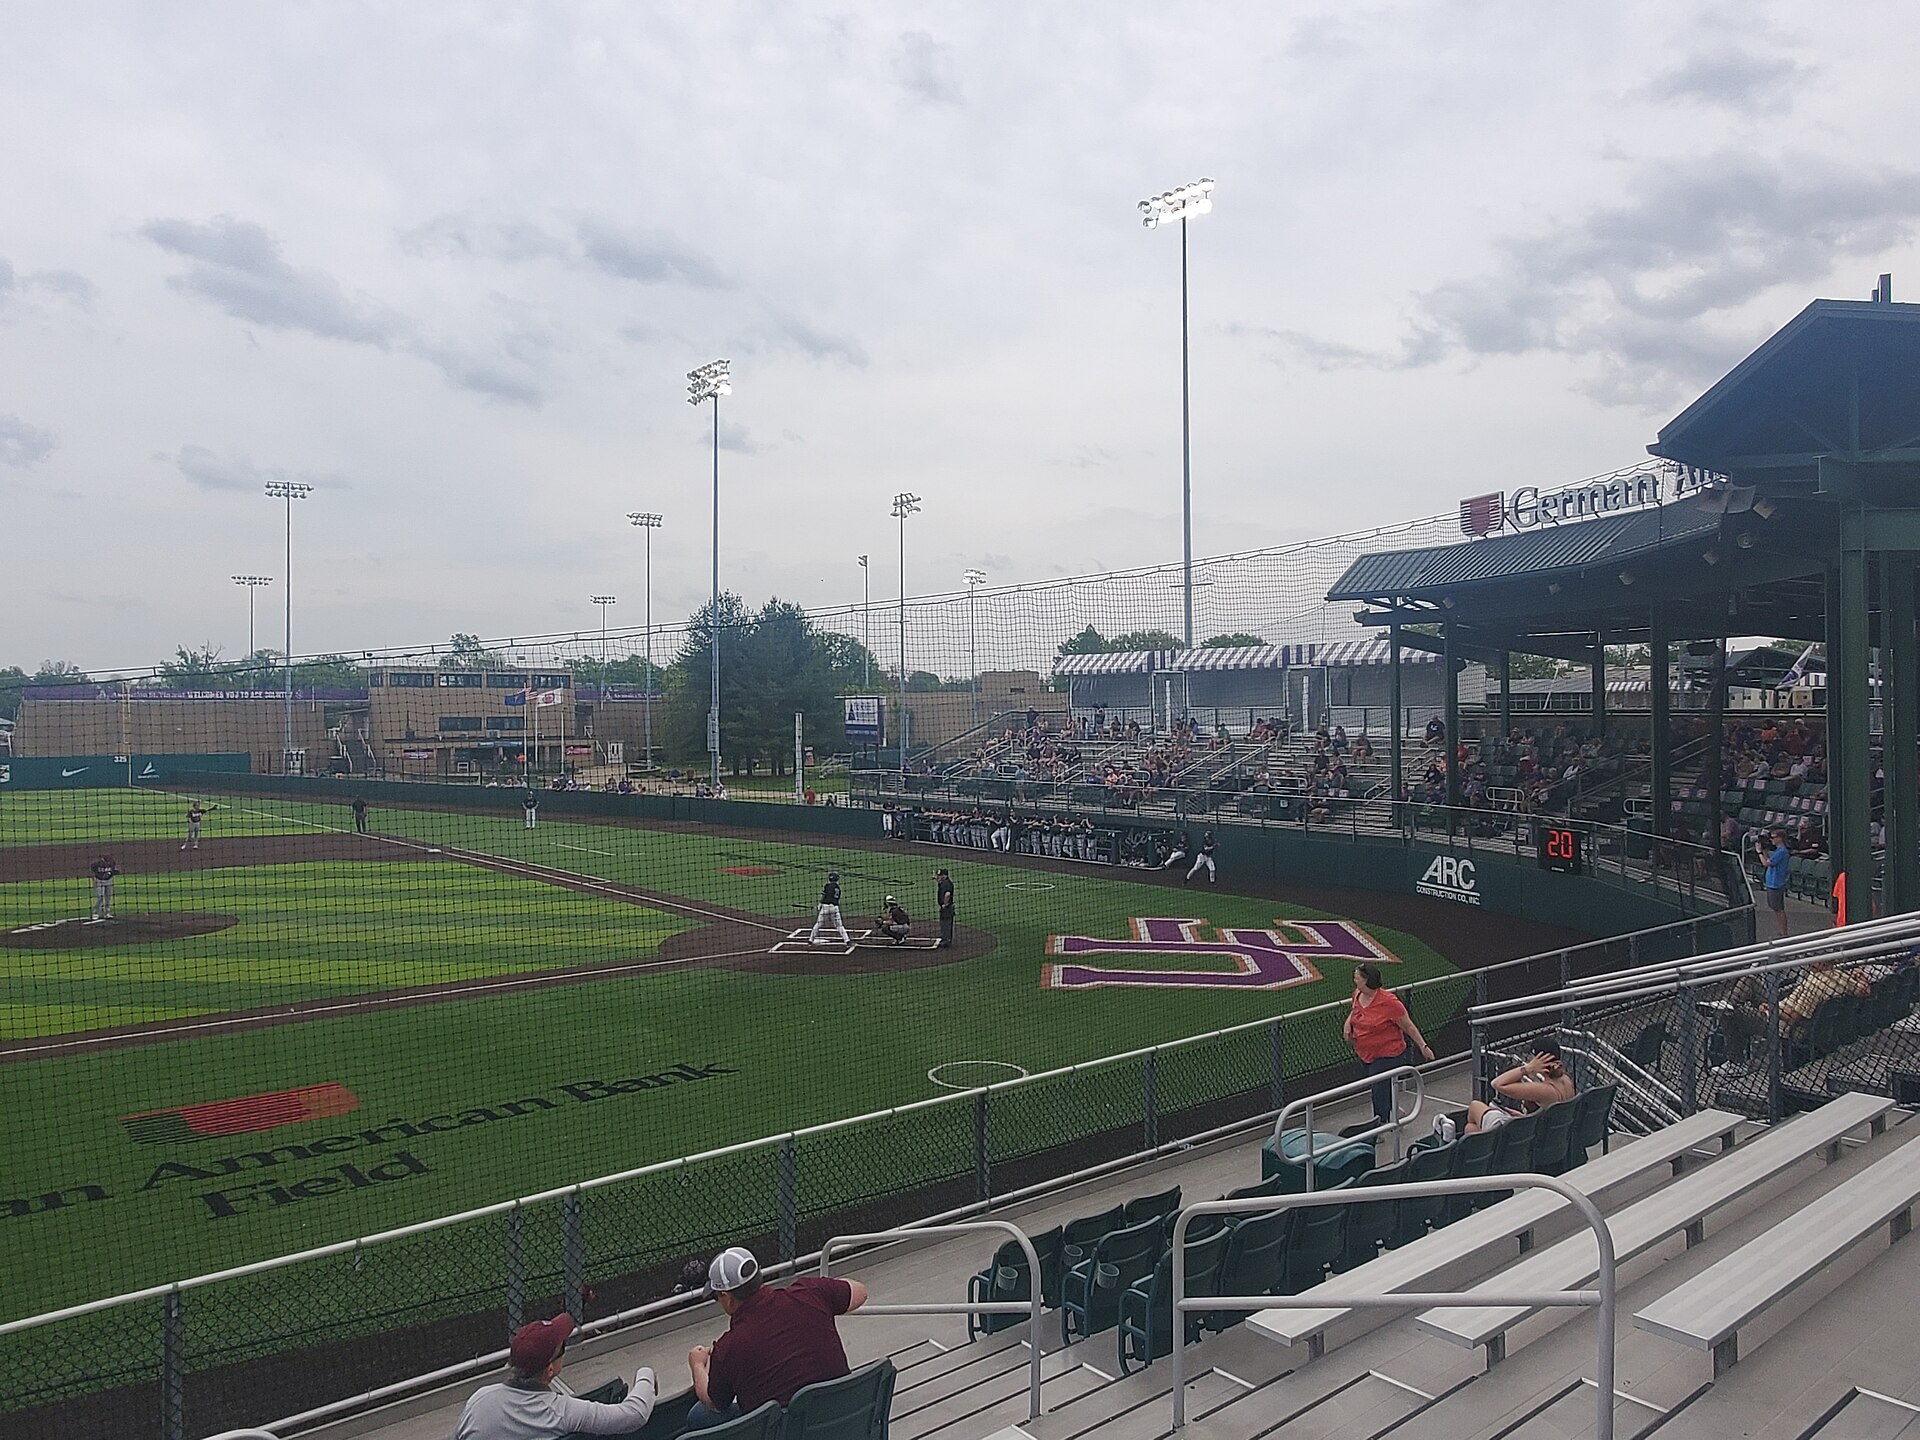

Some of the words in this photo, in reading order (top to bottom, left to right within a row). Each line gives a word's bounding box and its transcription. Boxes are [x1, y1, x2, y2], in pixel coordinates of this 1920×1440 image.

[1508, 473, 1658, 528] German
[187, 691, 224, 699] WELCOMES
[225, 691, 240, 699] YOU
[241, 691, 249, 699] TO
[1547, 830, 1573, 859] 20
[1422, 855, 1476, 890] ARC
[1416, 885, 1457, 900] CONSTRUCTION
[132, 1097, 558, 1193] American
[556, 1062, 741, 1101] Bank
[189, 1152, 430, 1221] Field
